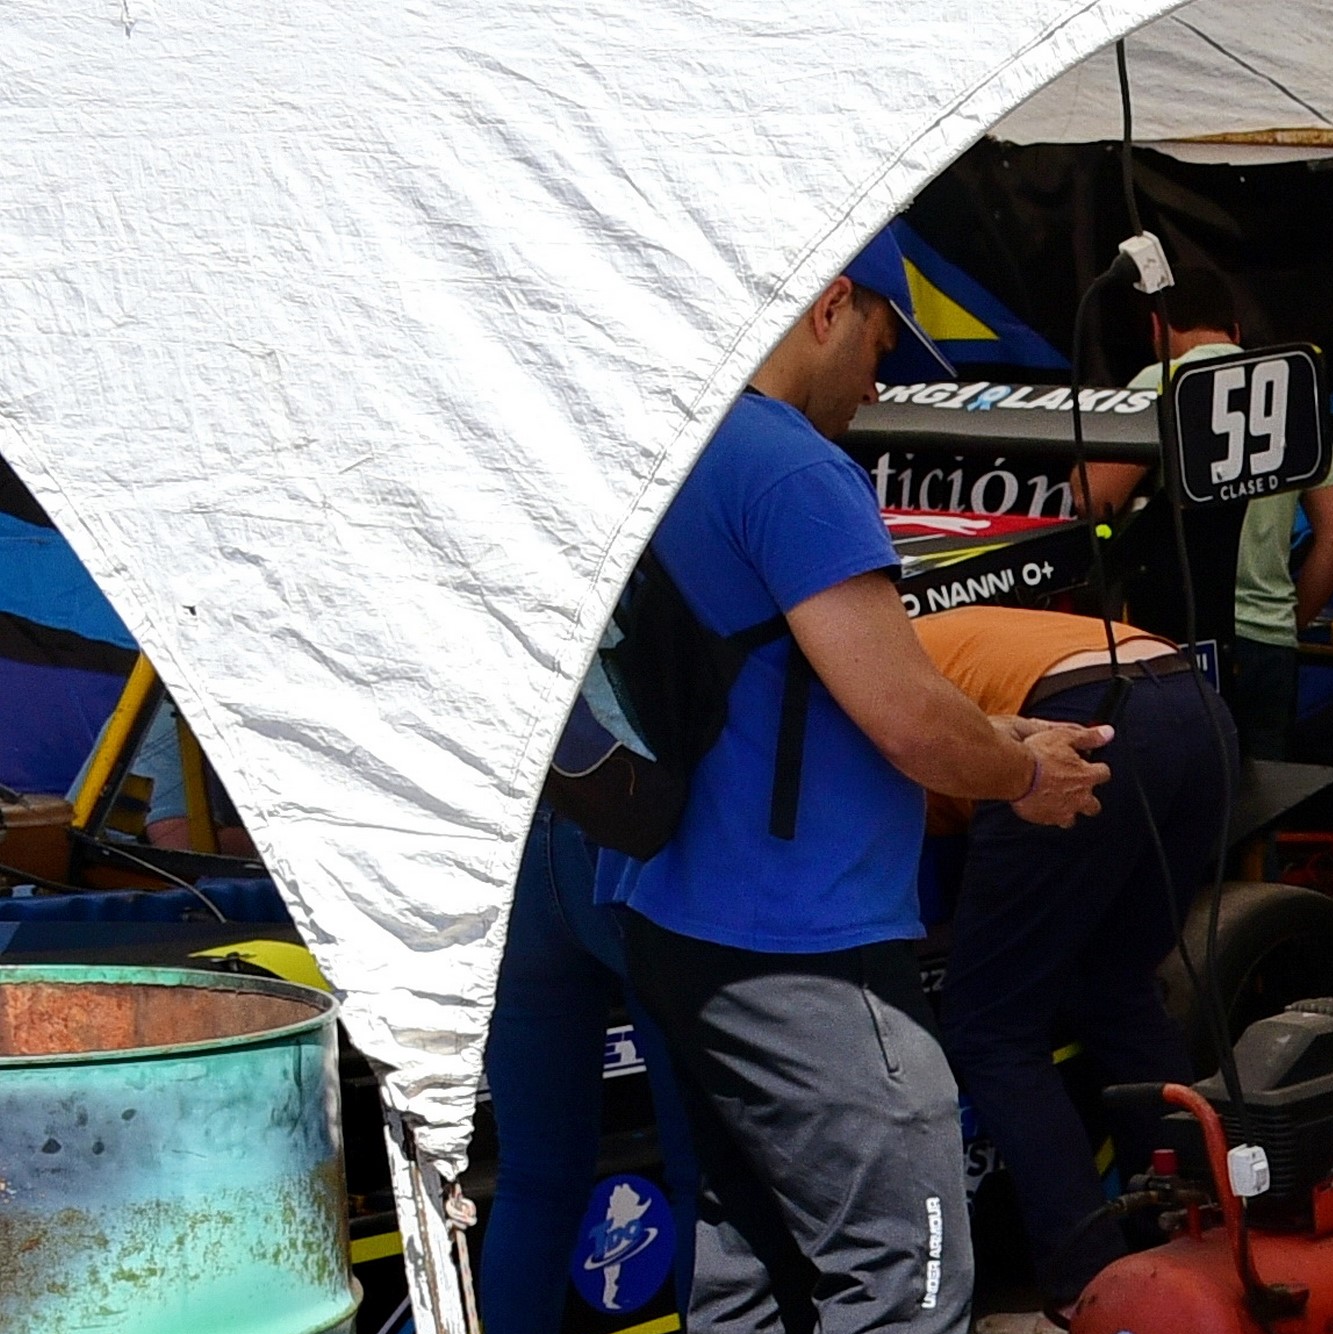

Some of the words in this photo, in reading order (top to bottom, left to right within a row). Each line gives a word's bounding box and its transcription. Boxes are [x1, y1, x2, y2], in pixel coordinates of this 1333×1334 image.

[1211, 359, 1289, 484] 59
[870, 452, 1077, 520] tición
[1220, 480, 1264, 501] CLASE
[1269, 475, 1279, 490] D
[927, 569, 1014, 612] NANNI
[926, 1196, 943, 1258] ARMOUR
